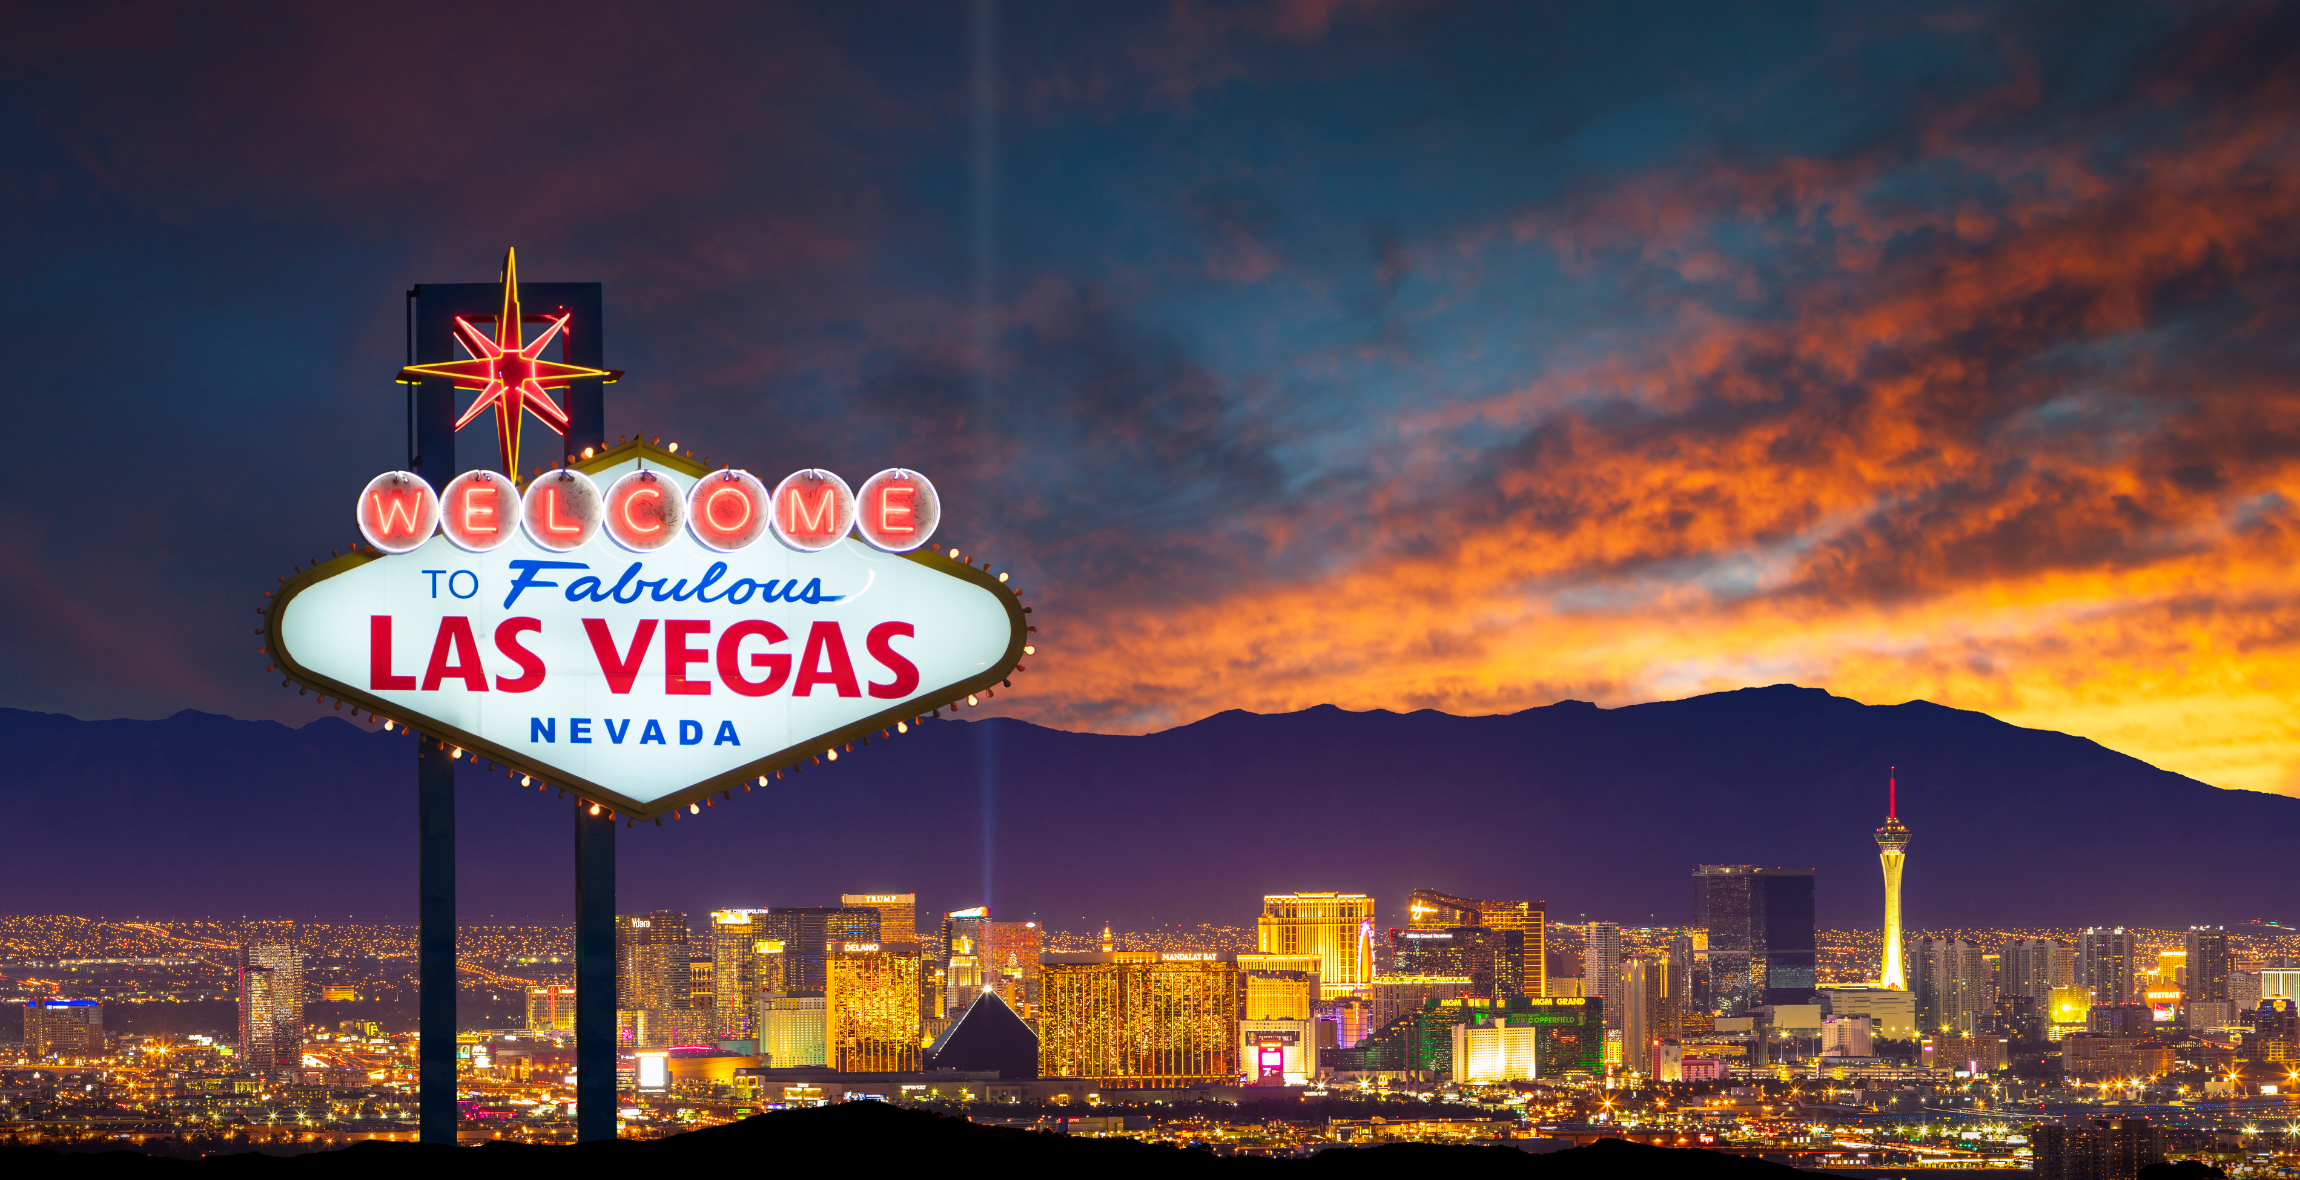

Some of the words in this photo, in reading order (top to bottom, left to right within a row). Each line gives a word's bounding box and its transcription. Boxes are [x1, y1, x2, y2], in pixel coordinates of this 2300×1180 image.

[369, 486, 918, 538] WELCOME
[422, 569, 479, 599] TO
[503, 559, 846, 610] Fabulous
[370, 615, 546, 693] LAS
[581, 618, 920, 699] VEGAS
[530, 717, 742, 747] NEVADA
[1441, 999, 1462, 1007] MGM
[1532, 998, 1553, 1006] MGM
[1556, 998, 1586, 1006] GRAND
[2147, 991, 2180, 999] WESTGATE
[1528, 1016, 1575, 1024] COPPERFIELD
